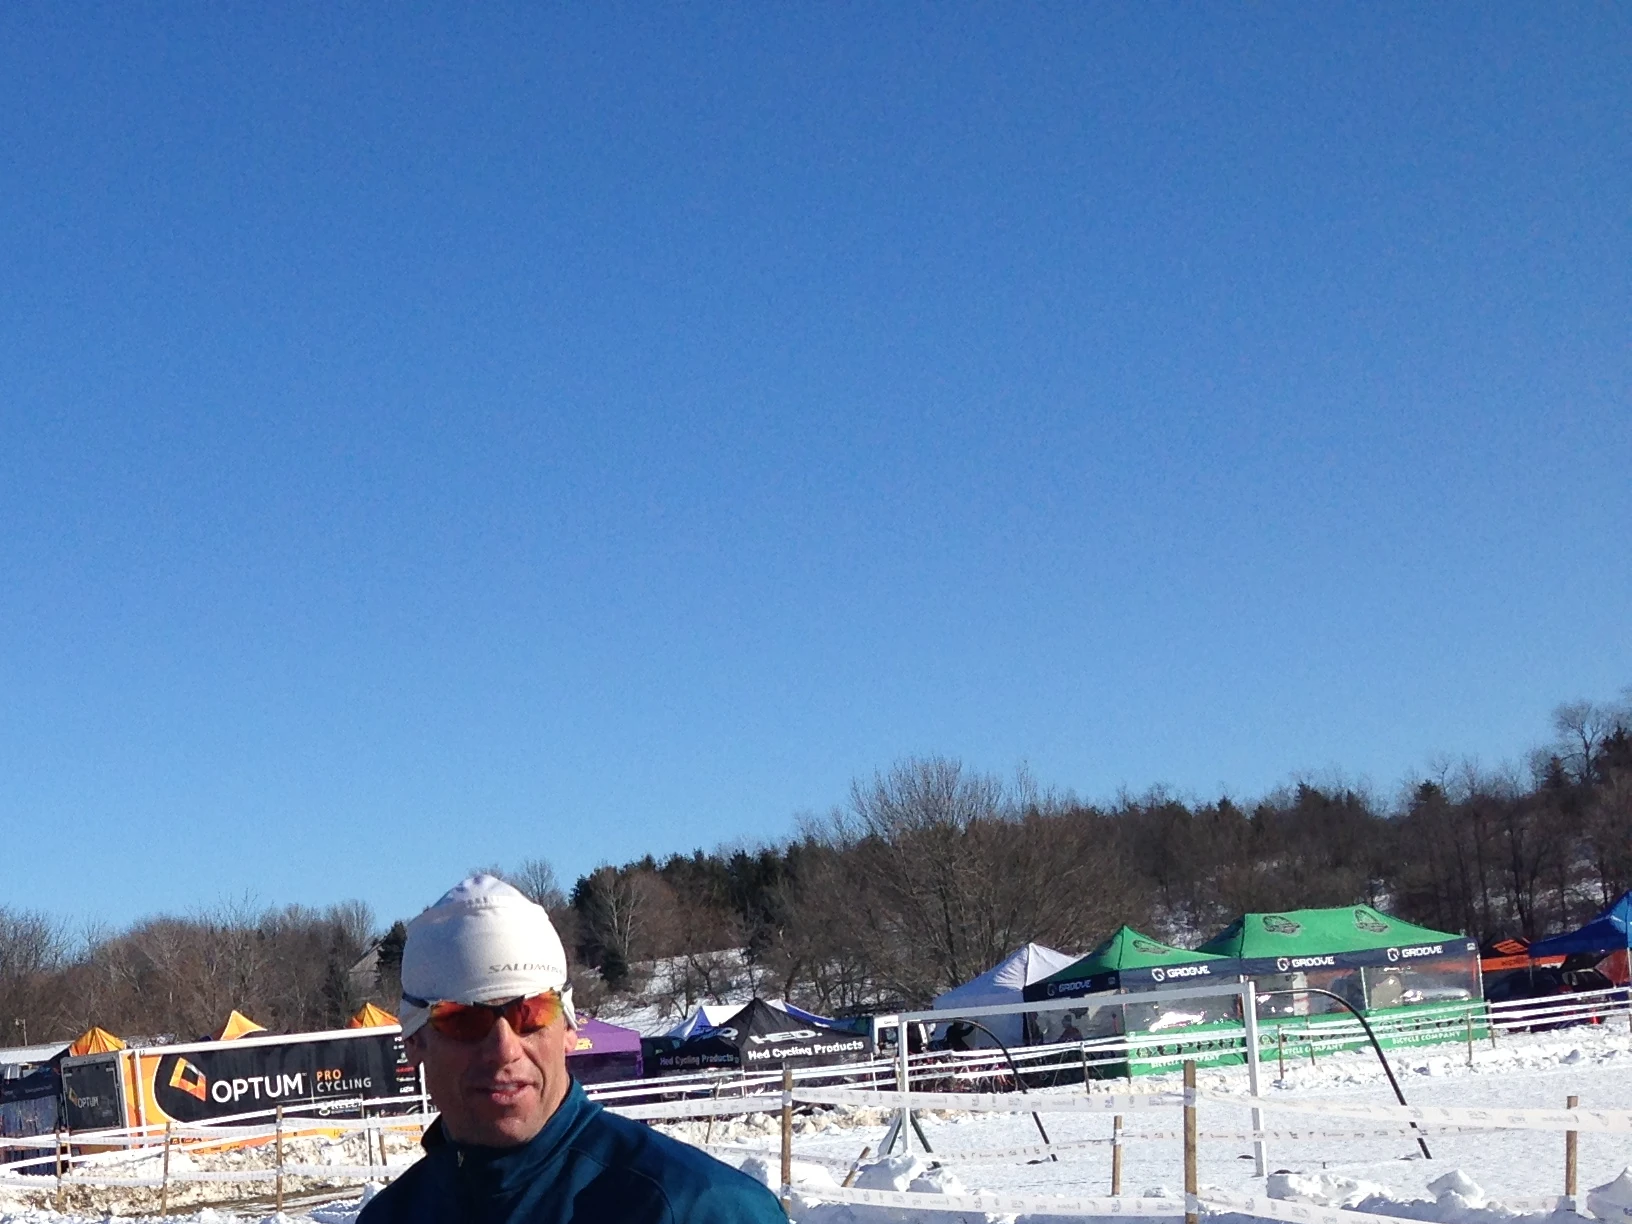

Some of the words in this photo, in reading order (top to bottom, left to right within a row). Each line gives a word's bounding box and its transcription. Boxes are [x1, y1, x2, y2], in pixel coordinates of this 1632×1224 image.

[1402, 945, 1443, 958] GROOVE
[1292, 956, 1335, 967] GROOVE
[1421, 1031, 1460, 1041] COMPANY
[748, 1050, 770, 1060] Hed
[772, 1046, 812, 1059] Cycling
[813, 1040, 864, 1054] Products
[316, 1068, 342, 1081] PRO
[212, 1073, 304, 1104] OPTUM
[316, 1077, 372, 1093] CYCLING
